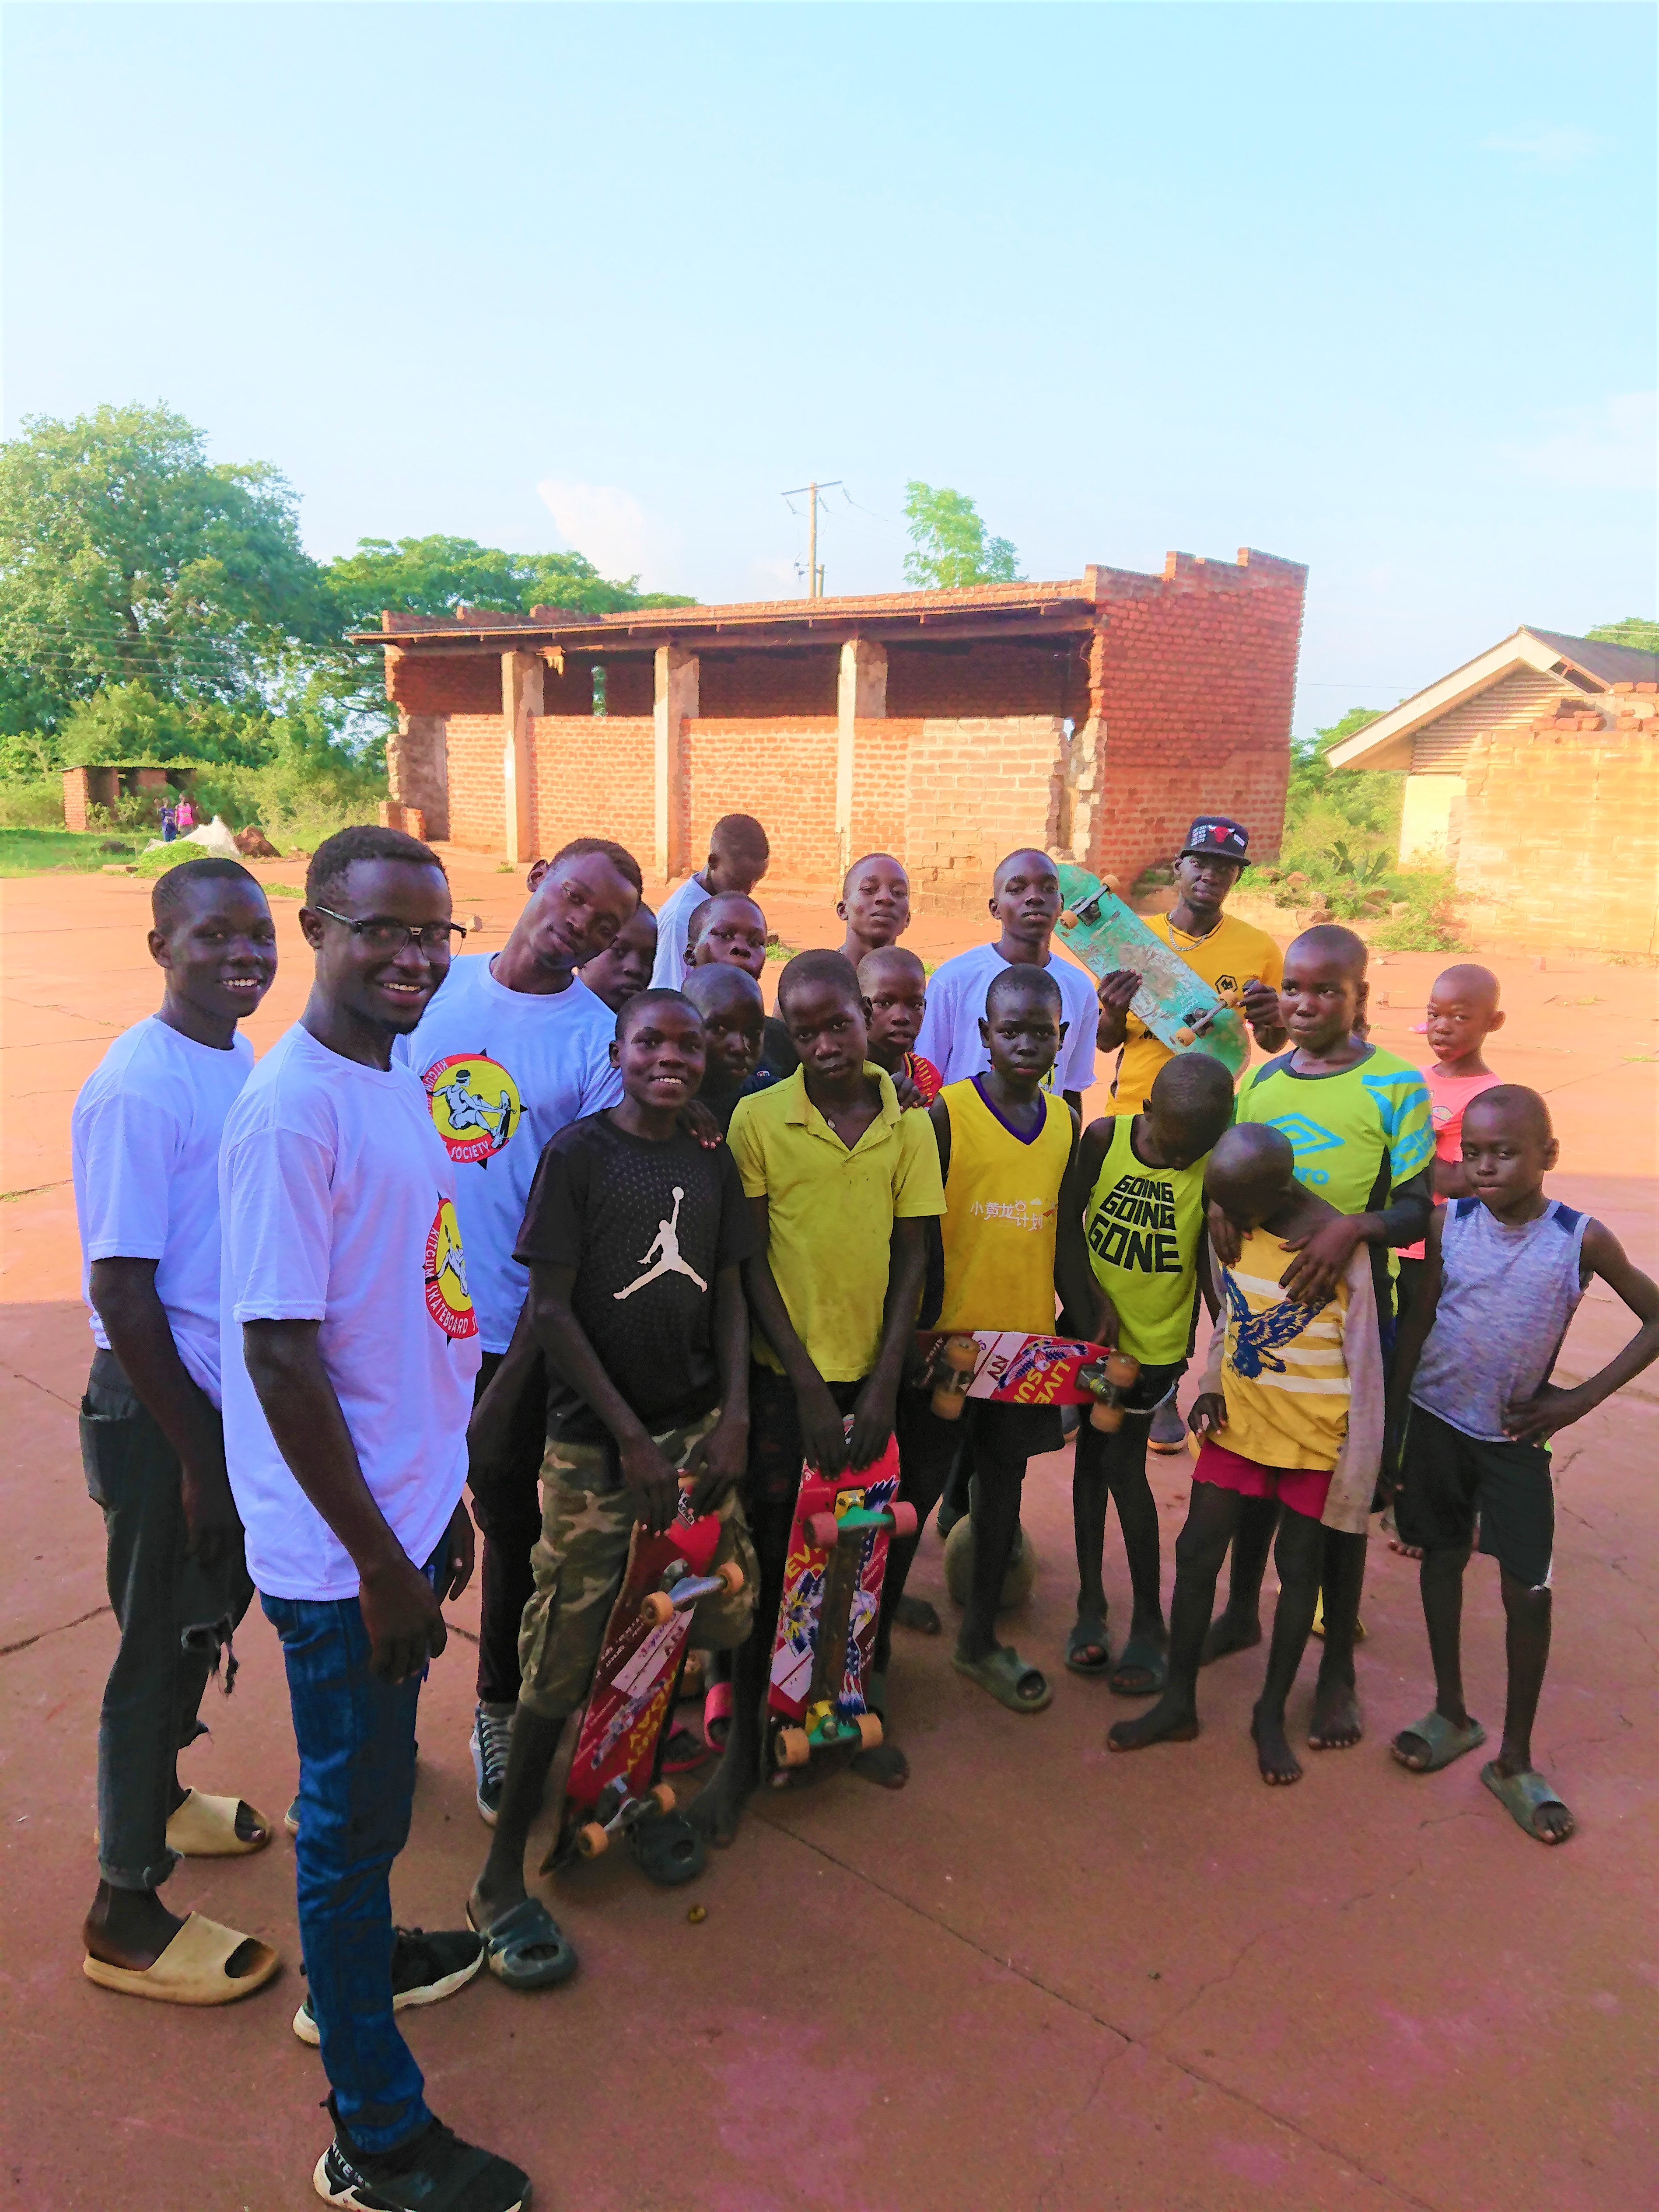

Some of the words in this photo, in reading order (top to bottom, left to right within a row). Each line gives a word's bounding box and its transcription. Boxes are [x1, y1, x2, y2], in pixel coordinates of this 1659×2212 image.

[424, 1059, 448, 1092] KITGUM
[450, 1140, 489, 1159] SOCIETY
[1114, 1175, 1175, 1204] GOING
[1099, 1191, 1176, 1230] GOING
[424, 1228, 439, 1278] KITGUM
[1088, 1213, 1183, 1273] GONE
[426, 1284, 469, 1334] SKATEBOARD
